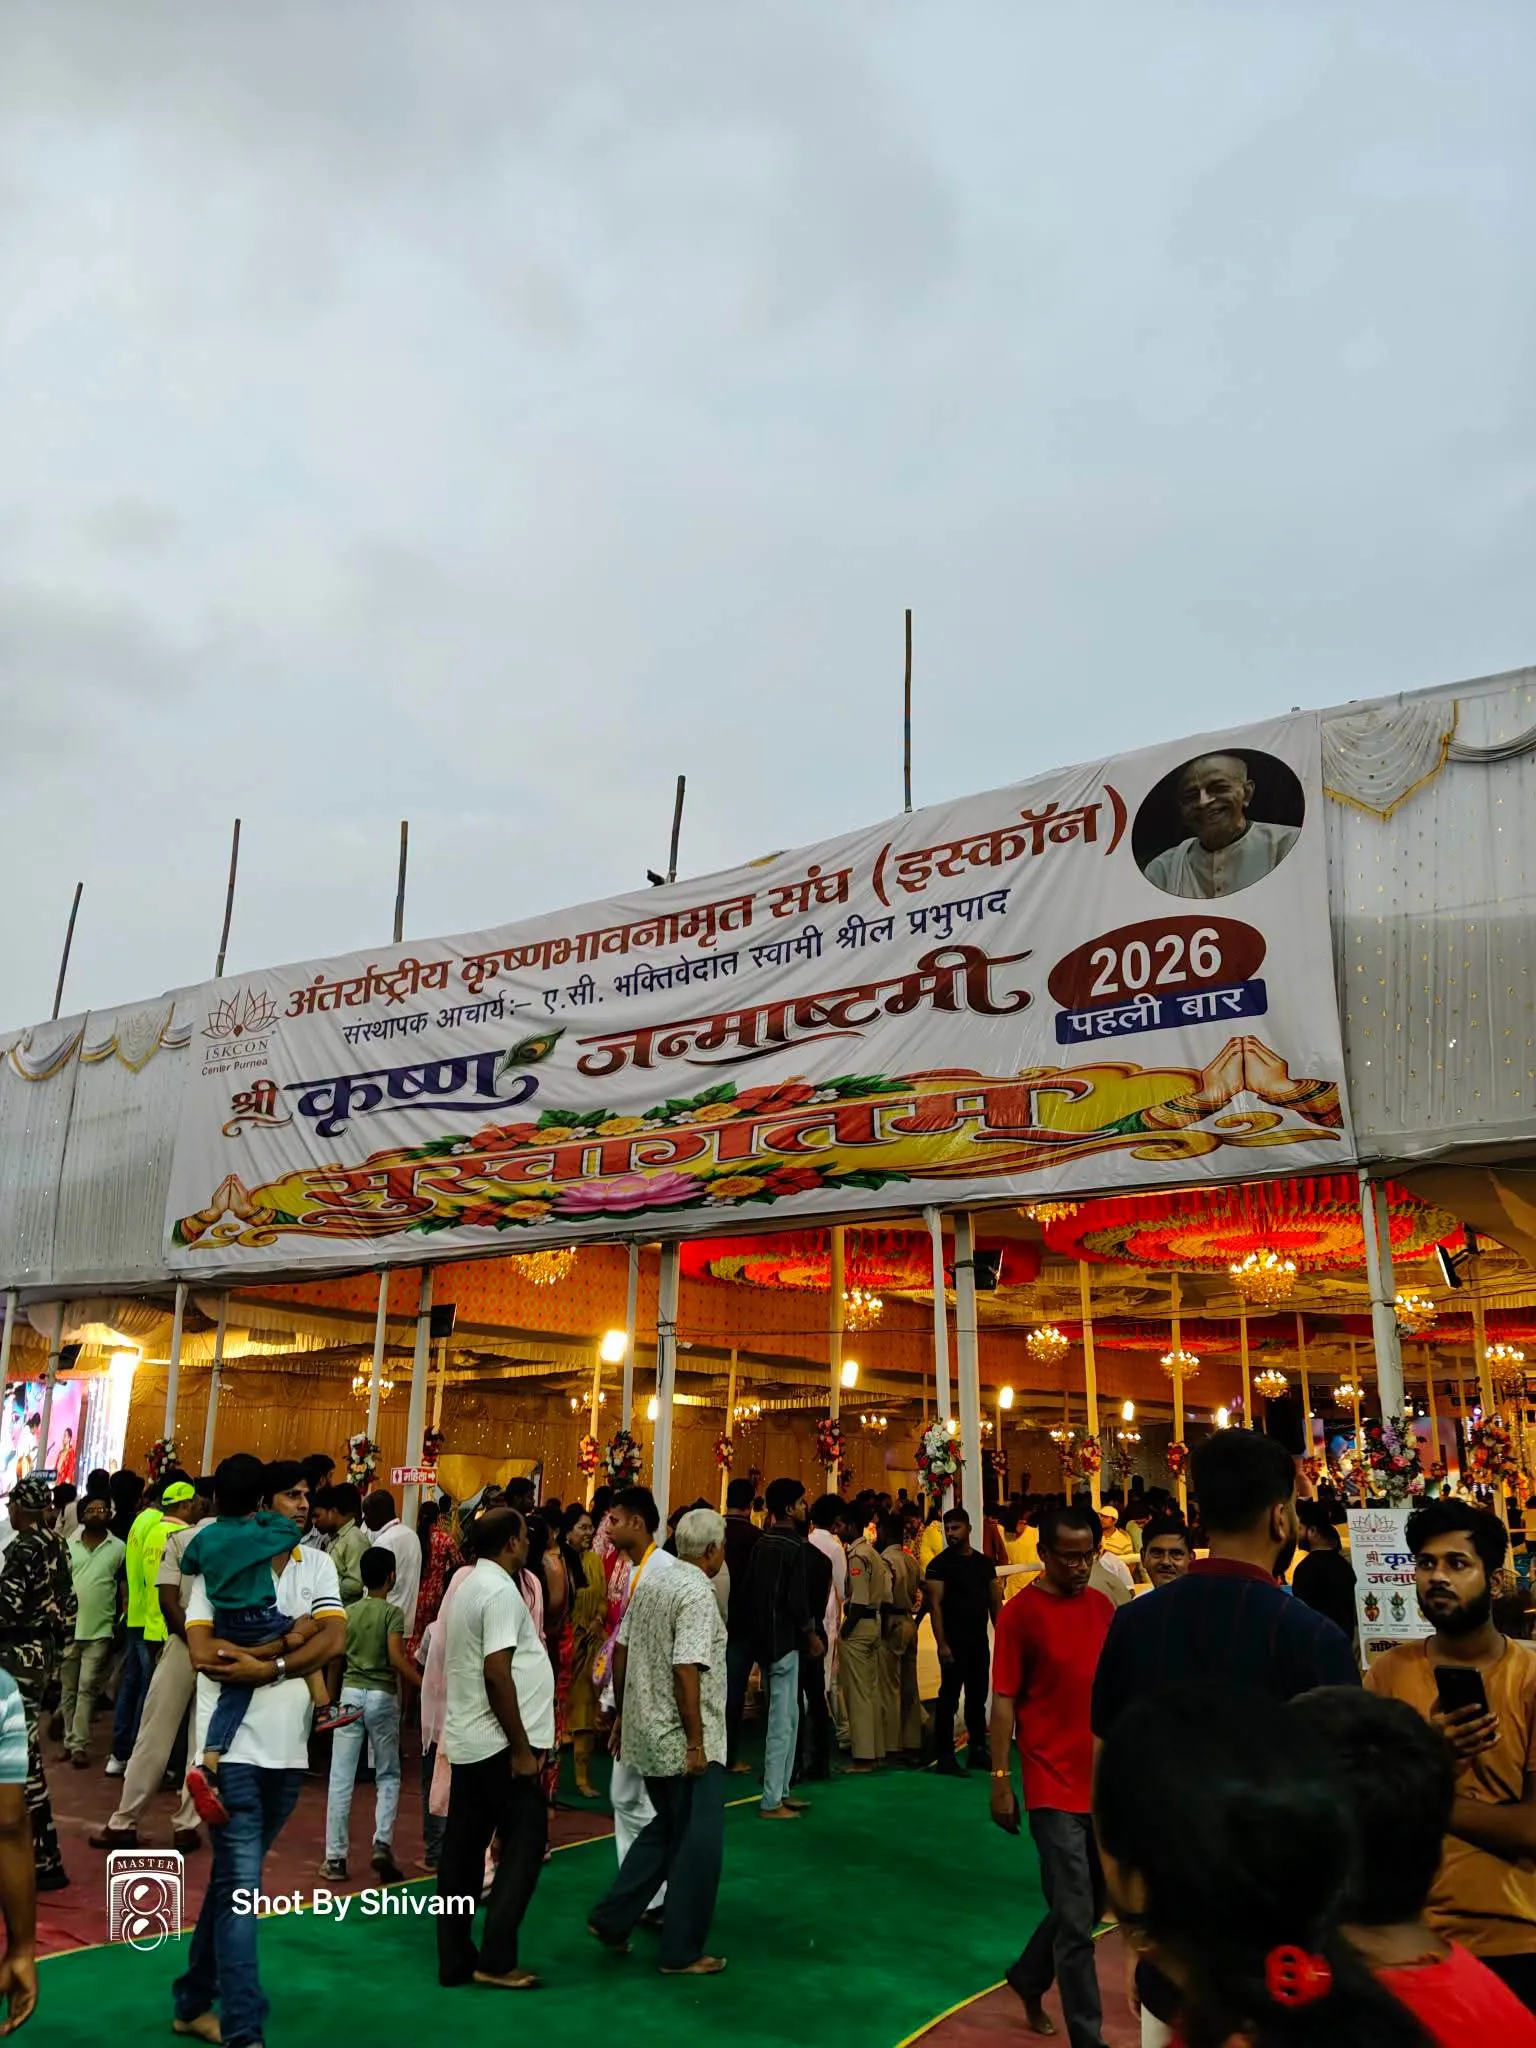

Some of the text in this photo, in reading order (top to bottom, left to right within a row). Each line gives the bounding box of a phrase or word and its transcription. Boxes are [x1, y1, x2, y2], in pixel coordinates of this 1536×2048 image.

[285, 785, 1128, 1018] अंतर्राष्ट्रीय कृष्णभावनामृत संघ (इस्कॉन)
[343, 1011, 430, 1045] संस्थापक
[614, 947, 740, 997] भक्तिवेदांत
[749, 924, 824, 968] स्वामी
[836, 914, 895, 949] श्रील
[907, 888, 1011, 940] प्रभुपाद
[1090, 928, 1222, 997] 2026
[1067, 988, 1245, 1036] पहली बार
[205, 1039, 269, 1061] ISKCON
[222, 945, 1034, 1138] श्री कृष्ण जन्माष्टमी
[234, 1058, 268, 1071] Purnea
[403, 1468, 428, 1482] महिला
